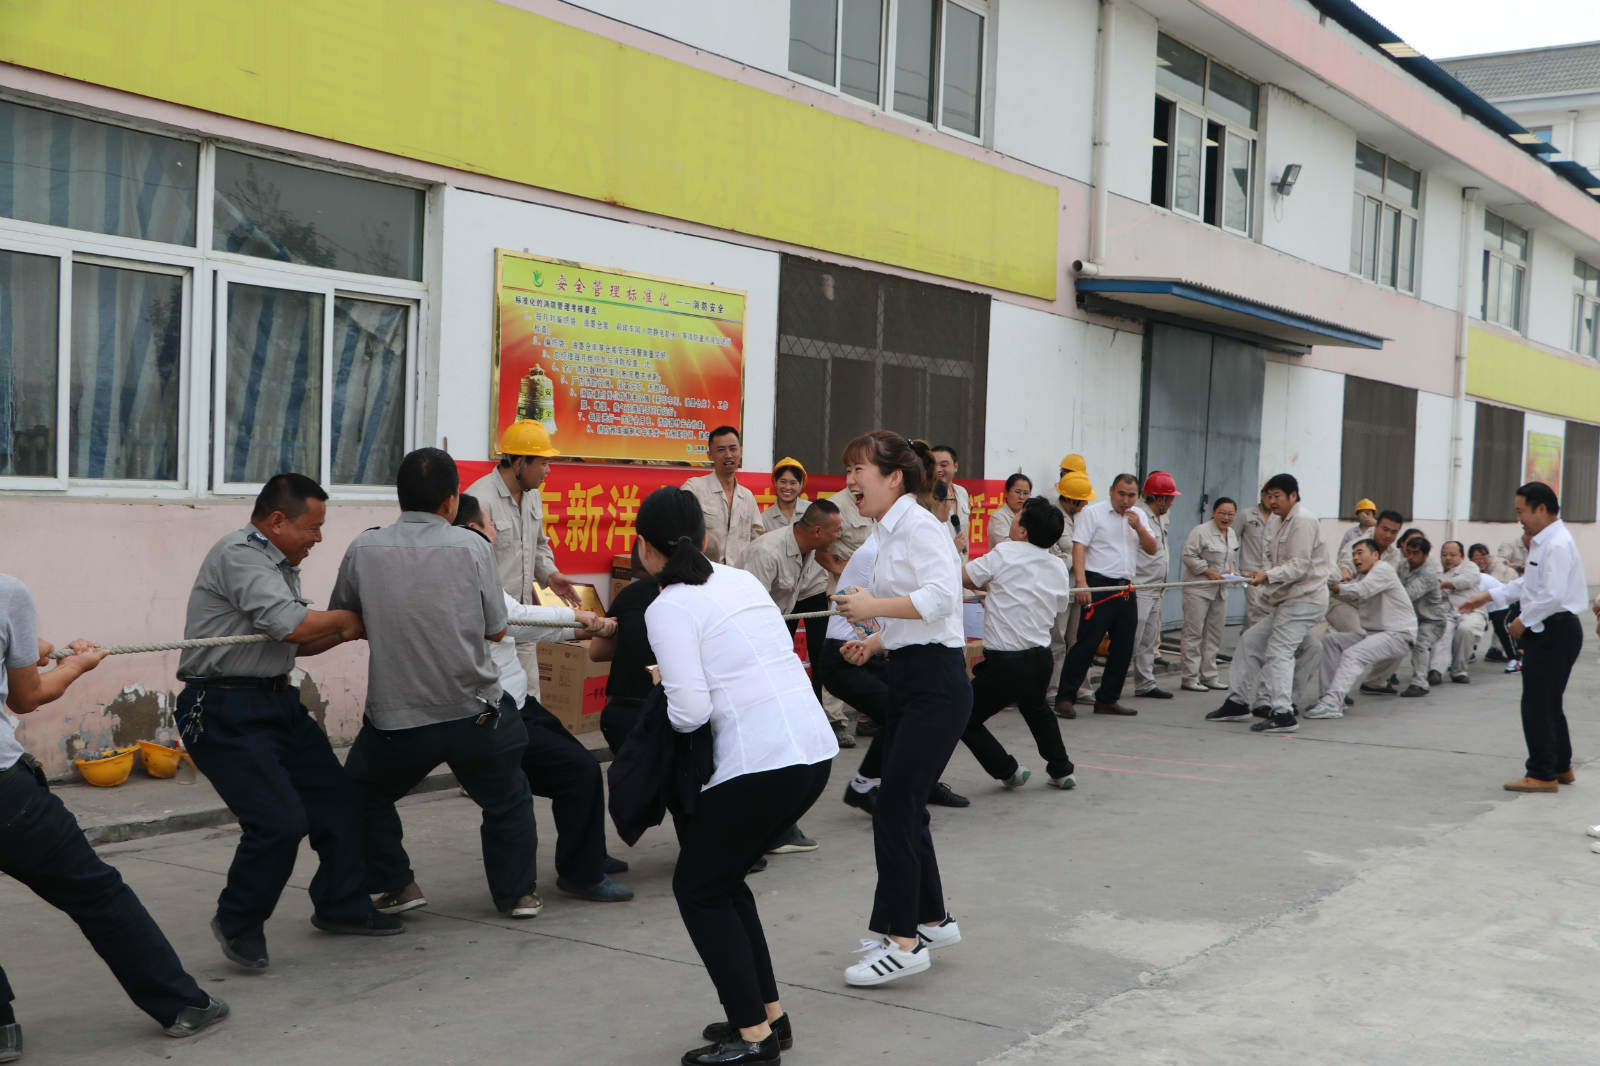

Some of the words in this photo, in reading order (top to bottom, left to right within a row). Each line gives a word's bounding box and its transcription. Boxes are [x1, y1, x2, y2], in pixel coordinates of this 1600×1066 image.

[555, 274, 669, 306] 安全管理标准化
